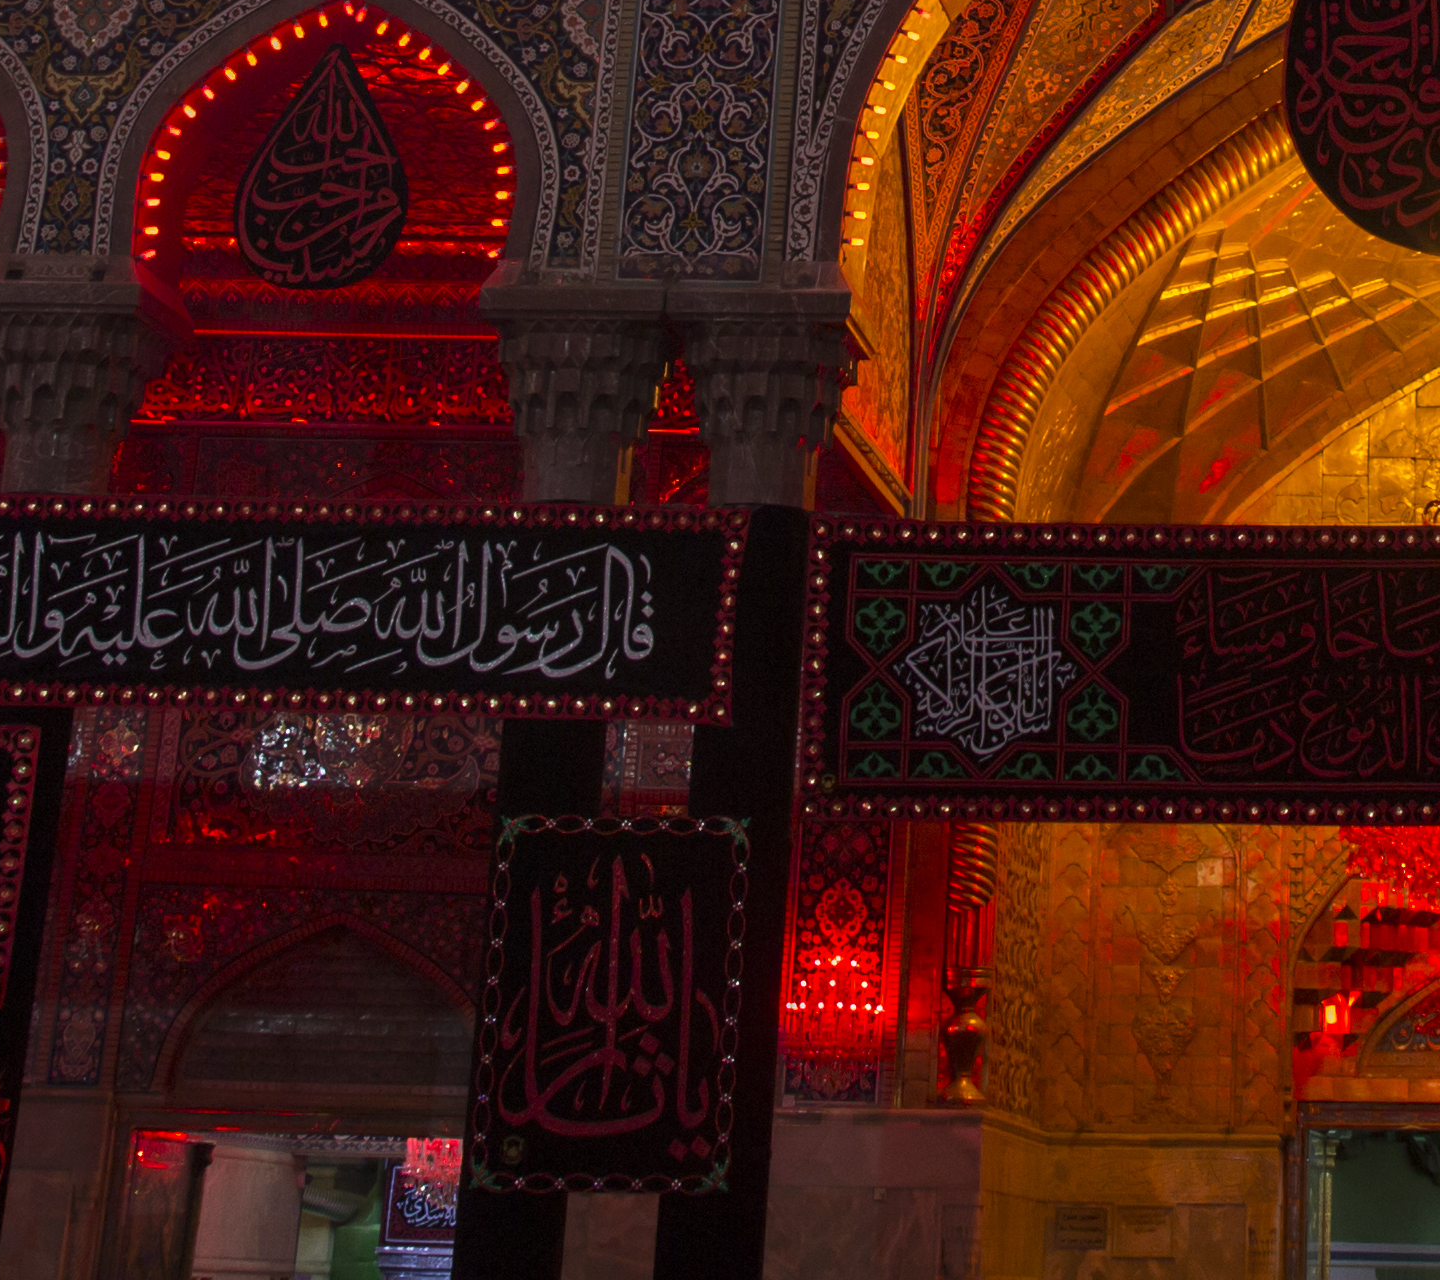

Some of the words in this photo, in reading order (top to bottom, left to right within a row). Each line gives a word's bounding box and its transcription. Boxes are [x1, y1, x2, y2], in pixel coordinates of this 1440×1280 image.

[59, 535, 184, 668] عليه
[187, 537, 276, 652] الله
[235, 537, 372, 670] صلى
[373, 539, 468, 650] الله
[416, 541, 583, 674] رسول
[539, 544, 656, 678] قال
